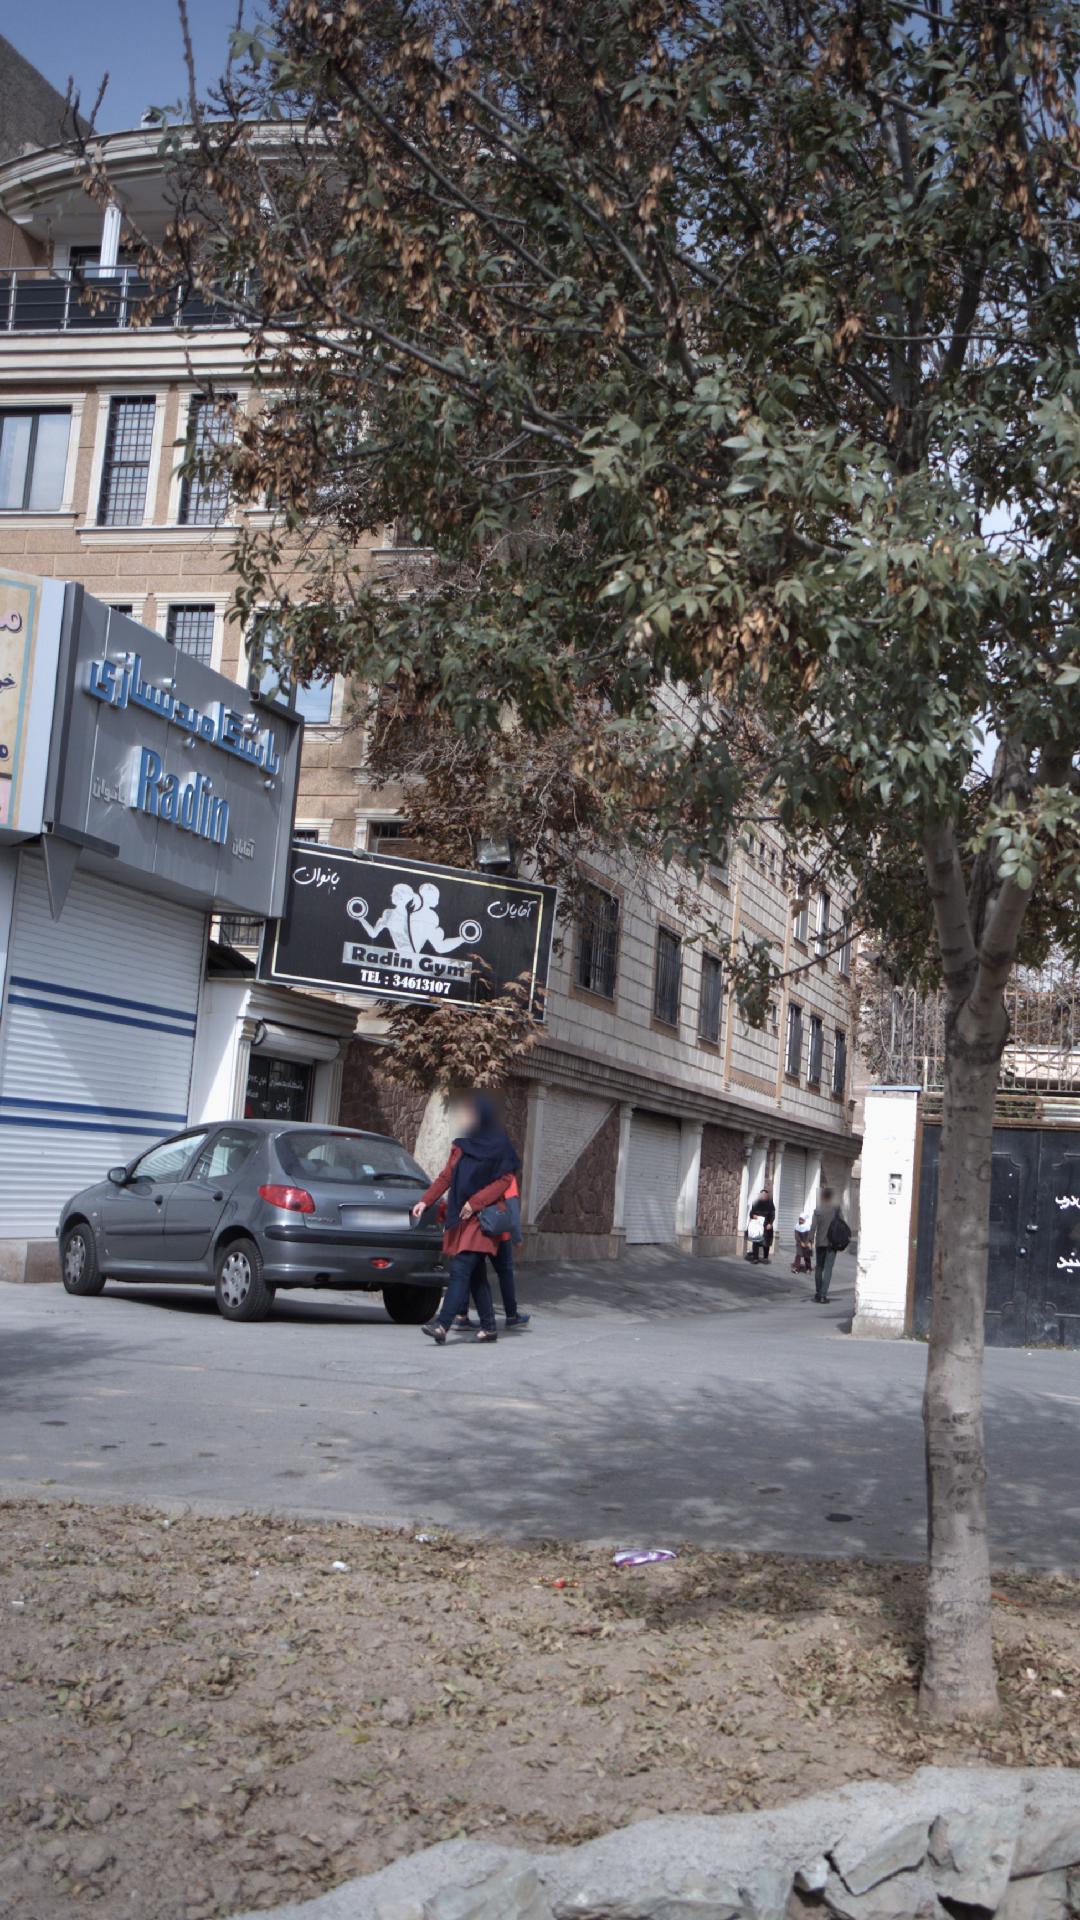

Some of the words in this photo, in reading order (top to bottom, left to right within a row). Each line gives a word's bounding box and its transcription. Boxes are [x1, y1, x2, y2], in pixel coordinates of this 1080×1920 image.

[89, 652, 199, 749] بدنسازی
[199, 701, 280, 790] باشگاه
[133, 746, 231, 845] Radin
[292, 867, 340, 891] بانوان
[487, 900, 537, 919] آقایان
[351, 945, 413, 970] Radin
[419, 954, 466, 978] Gym
[361, 969, 381, 984] TEL
[393, 974, 451, 994] 34613107
